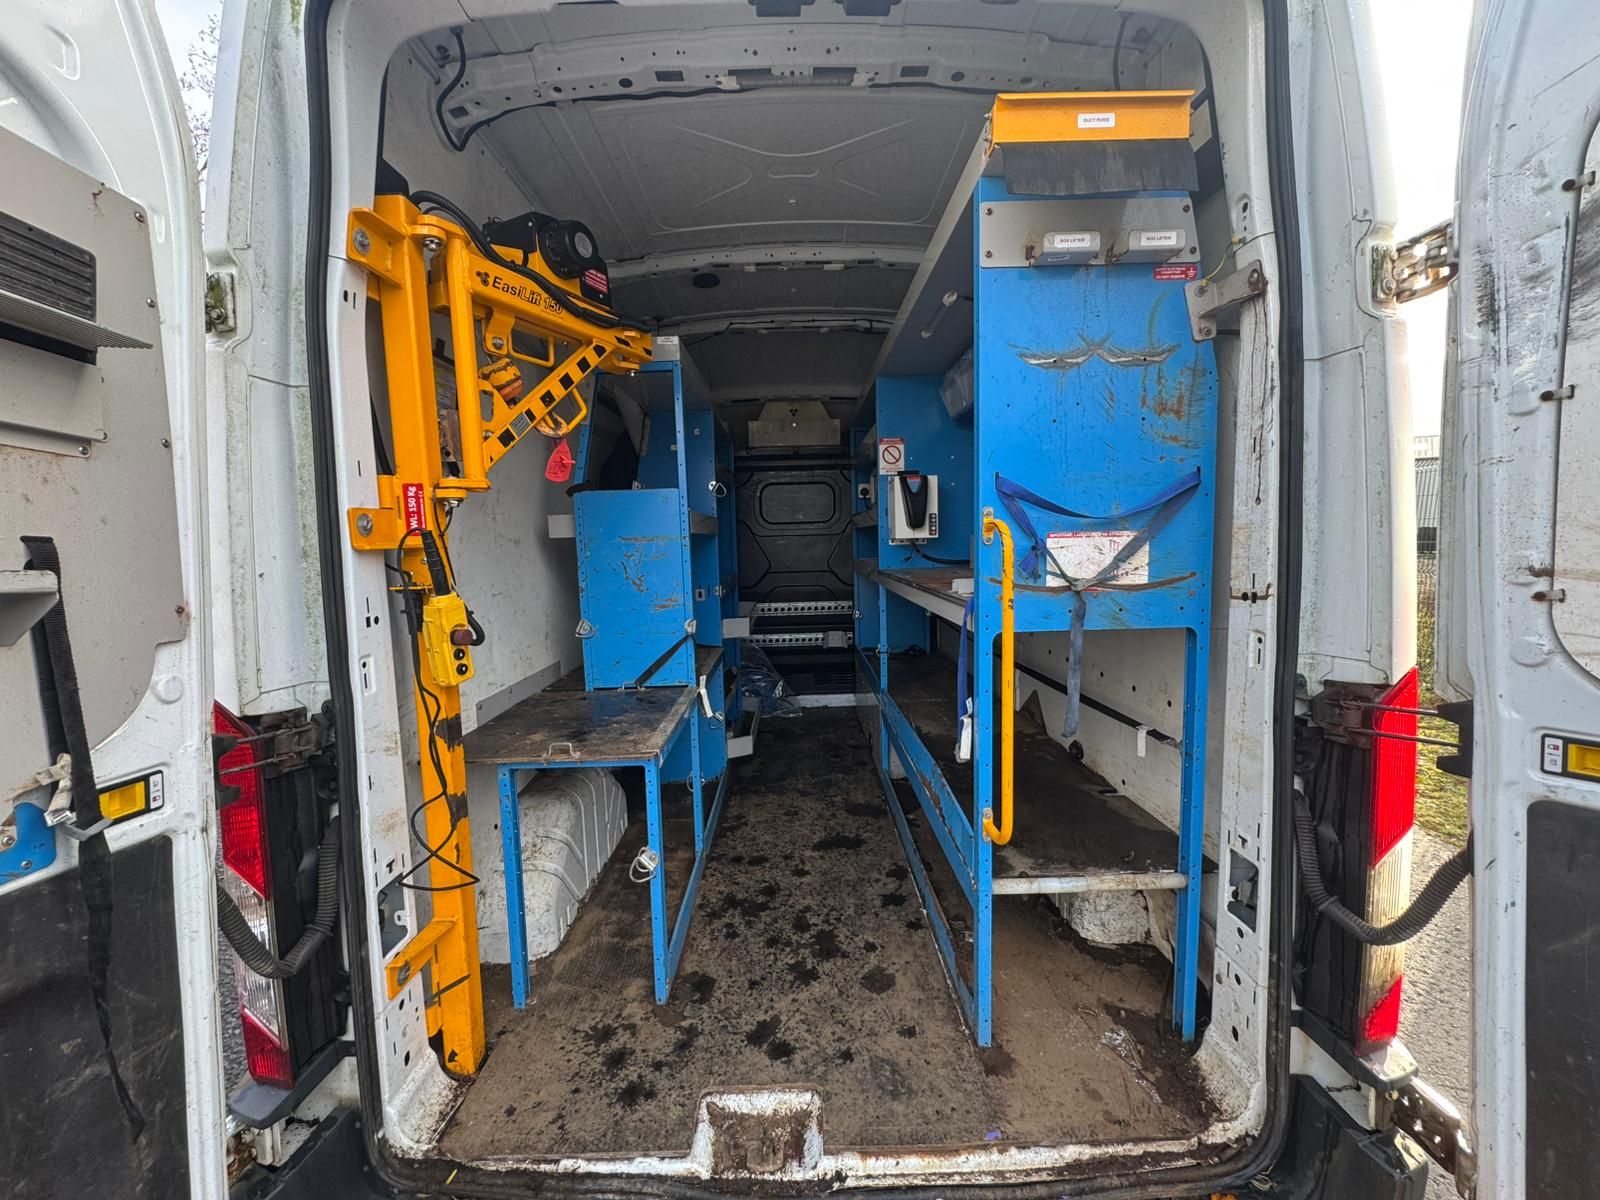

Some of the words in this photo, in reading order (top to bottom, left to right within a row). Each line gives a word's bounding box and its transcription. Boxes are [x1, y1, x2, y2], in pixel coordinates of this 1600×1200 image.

[492, 276, 542, 306] EasiLift
[543, 296, 564, 314] 150
[407, 486, 417, 496] Kg
[407, 497, 417, 512] 150
[409, 513, 419, 532] WL:
